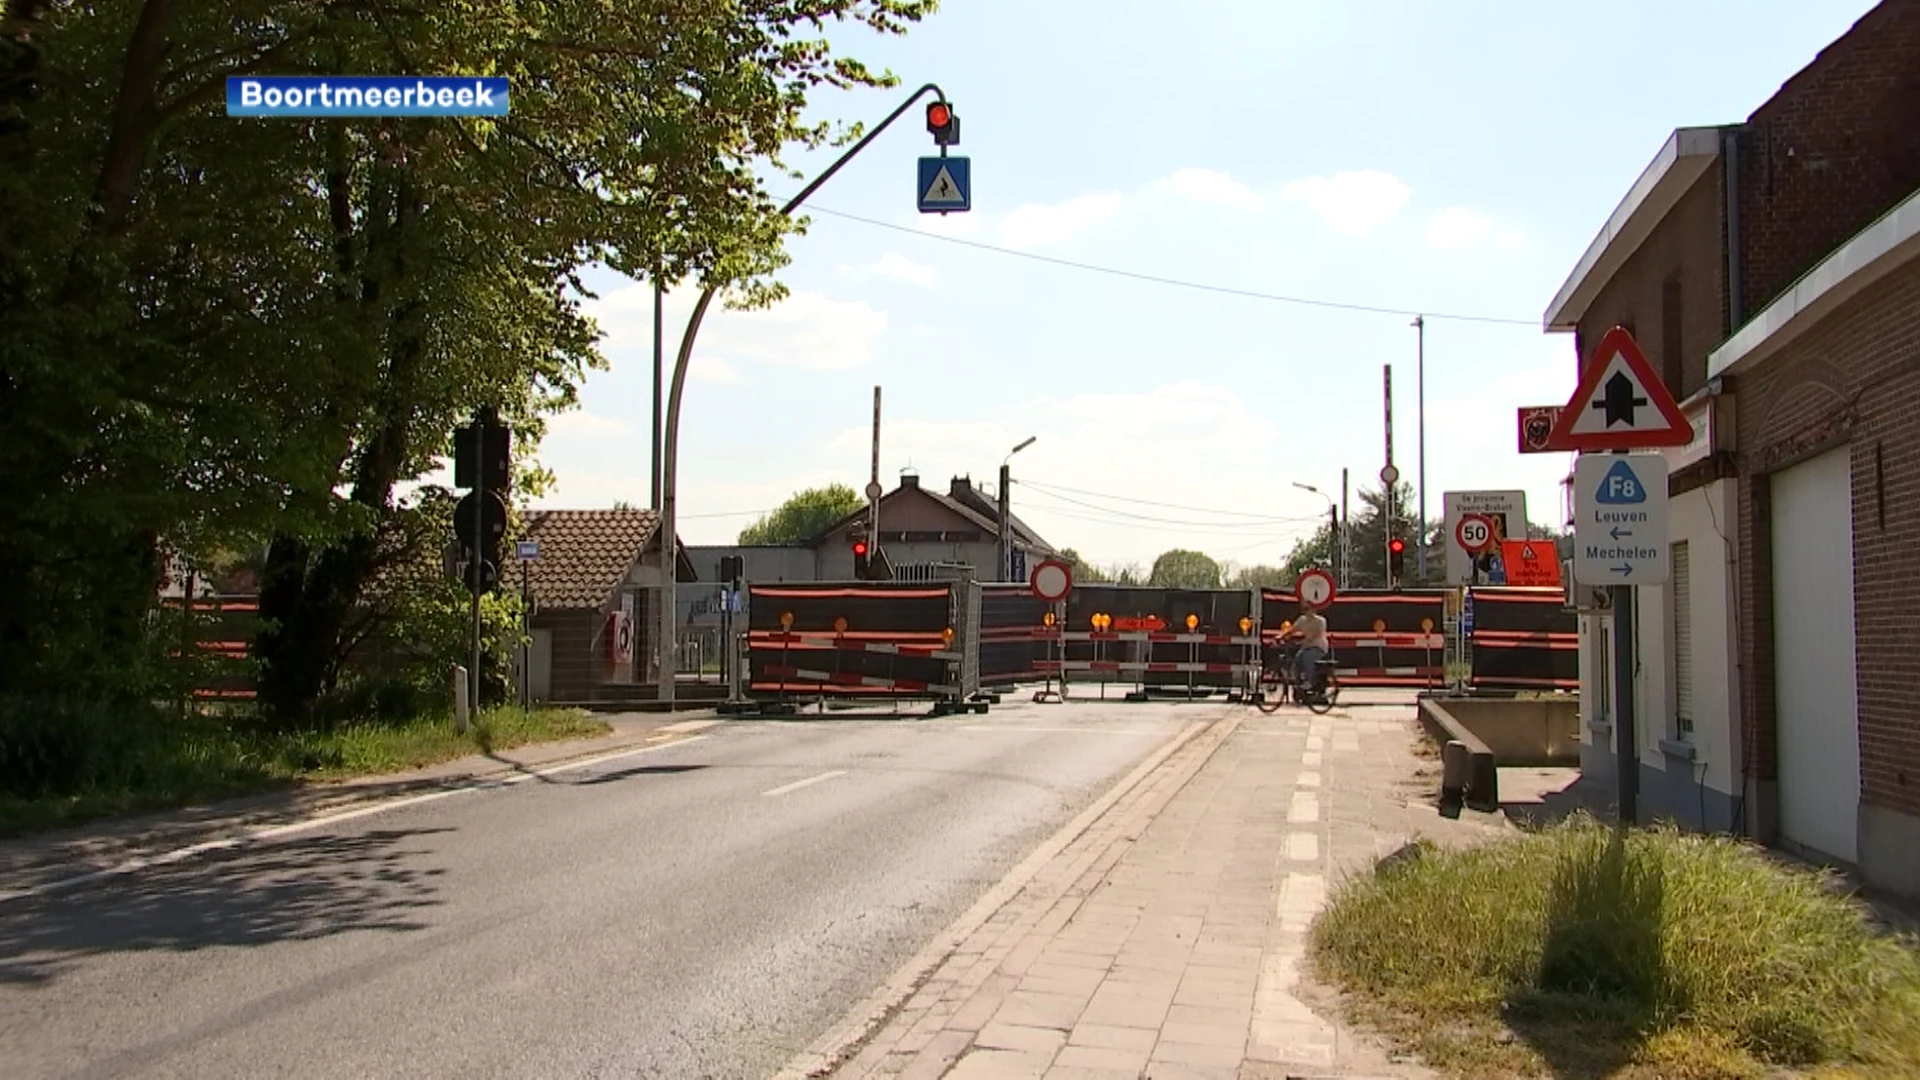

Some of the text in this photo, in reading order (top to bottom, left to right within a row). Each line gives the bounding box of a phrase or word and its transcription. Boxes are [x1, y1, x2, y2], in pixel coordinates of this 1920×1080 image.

[1608, 475, 1636, 498] F8
[1594, 510, 1648, 522] Leuven
[1463, 525, 1487, 541] 50
[1586, 546, 1657, 559] Mechelen
